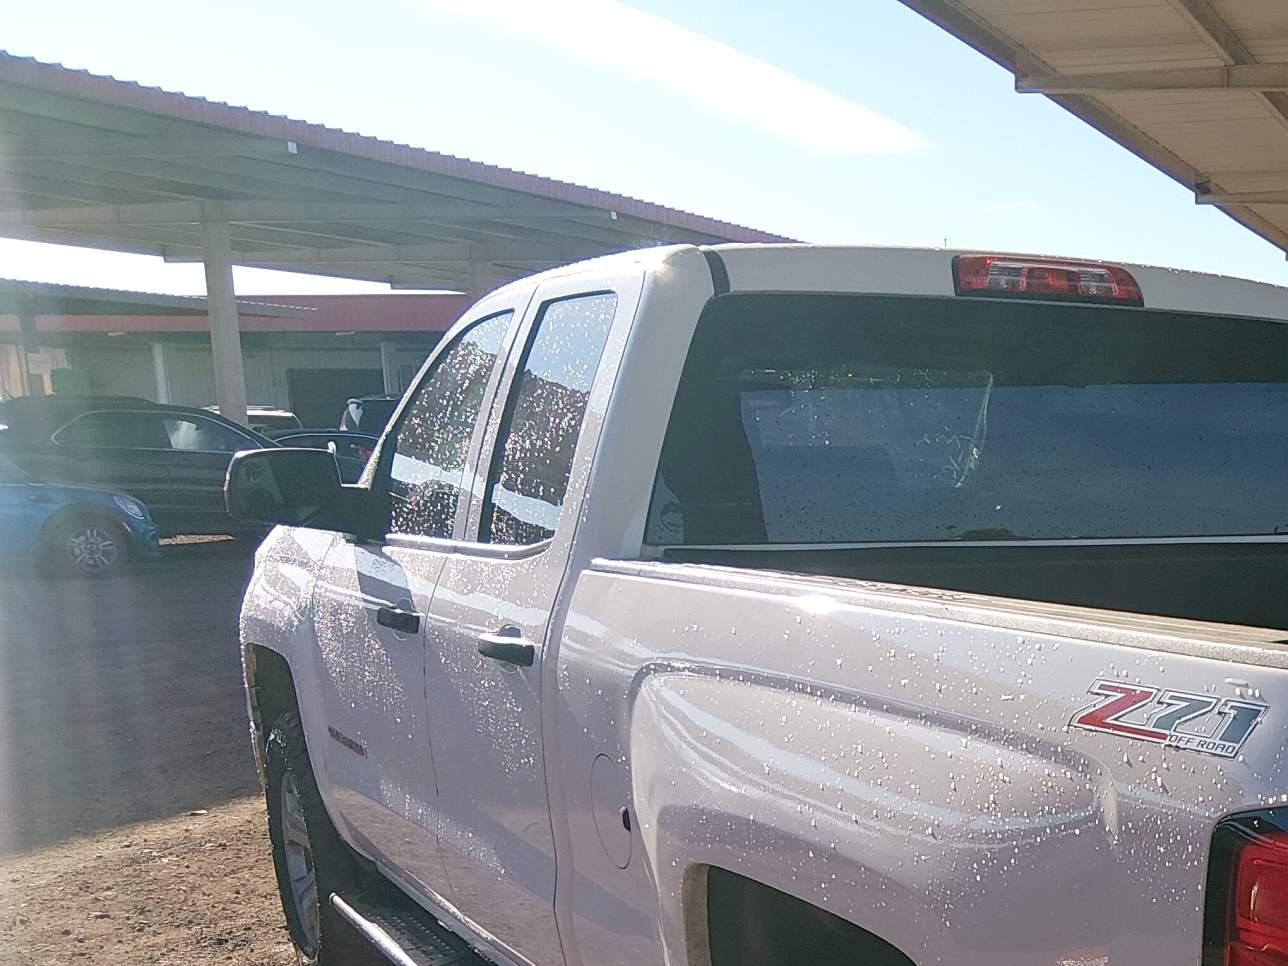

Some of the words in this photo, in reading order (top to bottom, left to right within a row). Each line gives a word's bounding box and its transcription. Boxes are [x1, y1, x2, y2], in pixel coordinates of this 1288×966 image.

[1067, 678, 1270, 753] Z71
[1168, 734, 1194, 747] OFF
[1197, 739, 1237, 754] ROAD
